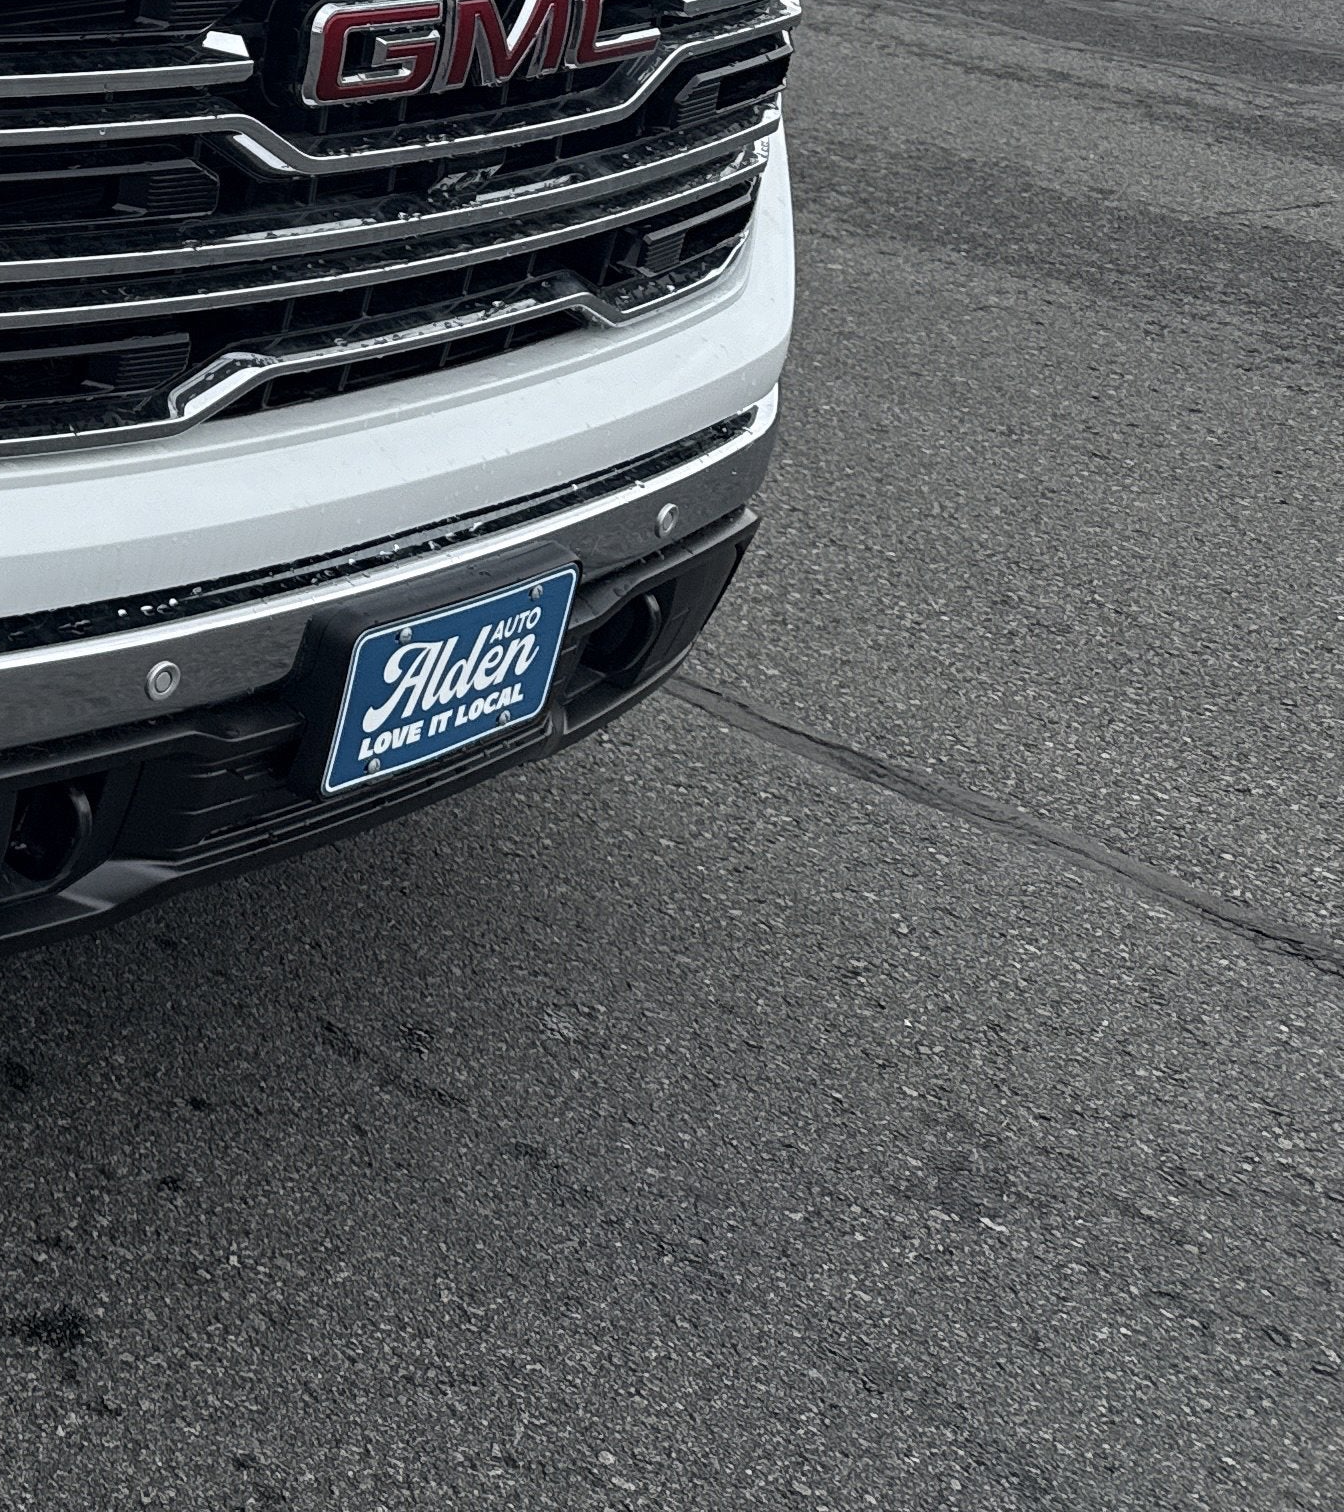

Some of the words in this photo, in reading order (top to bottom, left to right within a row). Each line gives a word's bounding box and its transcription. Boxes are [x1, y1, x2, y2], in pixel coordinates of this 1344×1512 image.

[489, 607, 542, 643] AUTO
[362, 625, 540, 732] Alden
[357, 719, 424, 760] LOVE
[427, 711, 454, 737] IT
[455, 683, 524, 727] LOCAL
